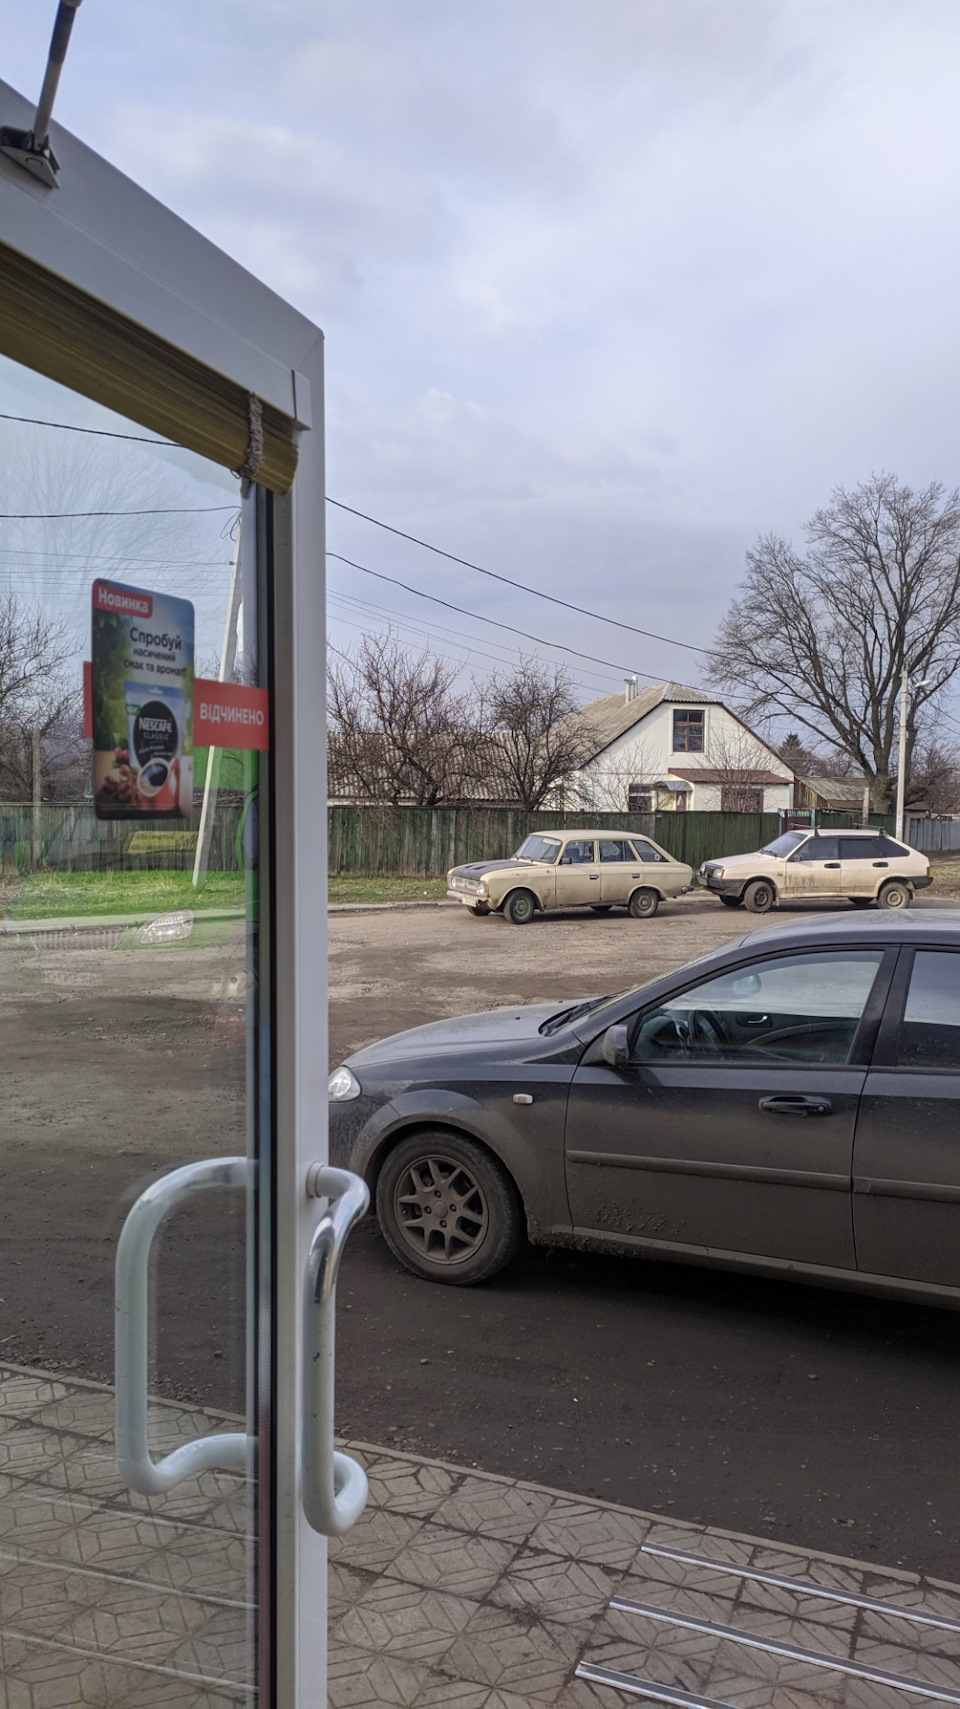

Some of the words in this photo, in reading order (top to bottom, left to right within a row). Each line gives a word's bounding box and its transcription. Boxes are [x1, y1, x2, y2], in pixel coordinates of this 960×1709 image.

[98, 588, 149, 613] Новинка
[130, 627, 182, 651] Спробуй
[124, 660, 143, 670] смак
[146, 663, 154, 672] та
[133, 648, 176, 662] насичений
[200, 703, 264, 726] ВІДЧИНЕНО
